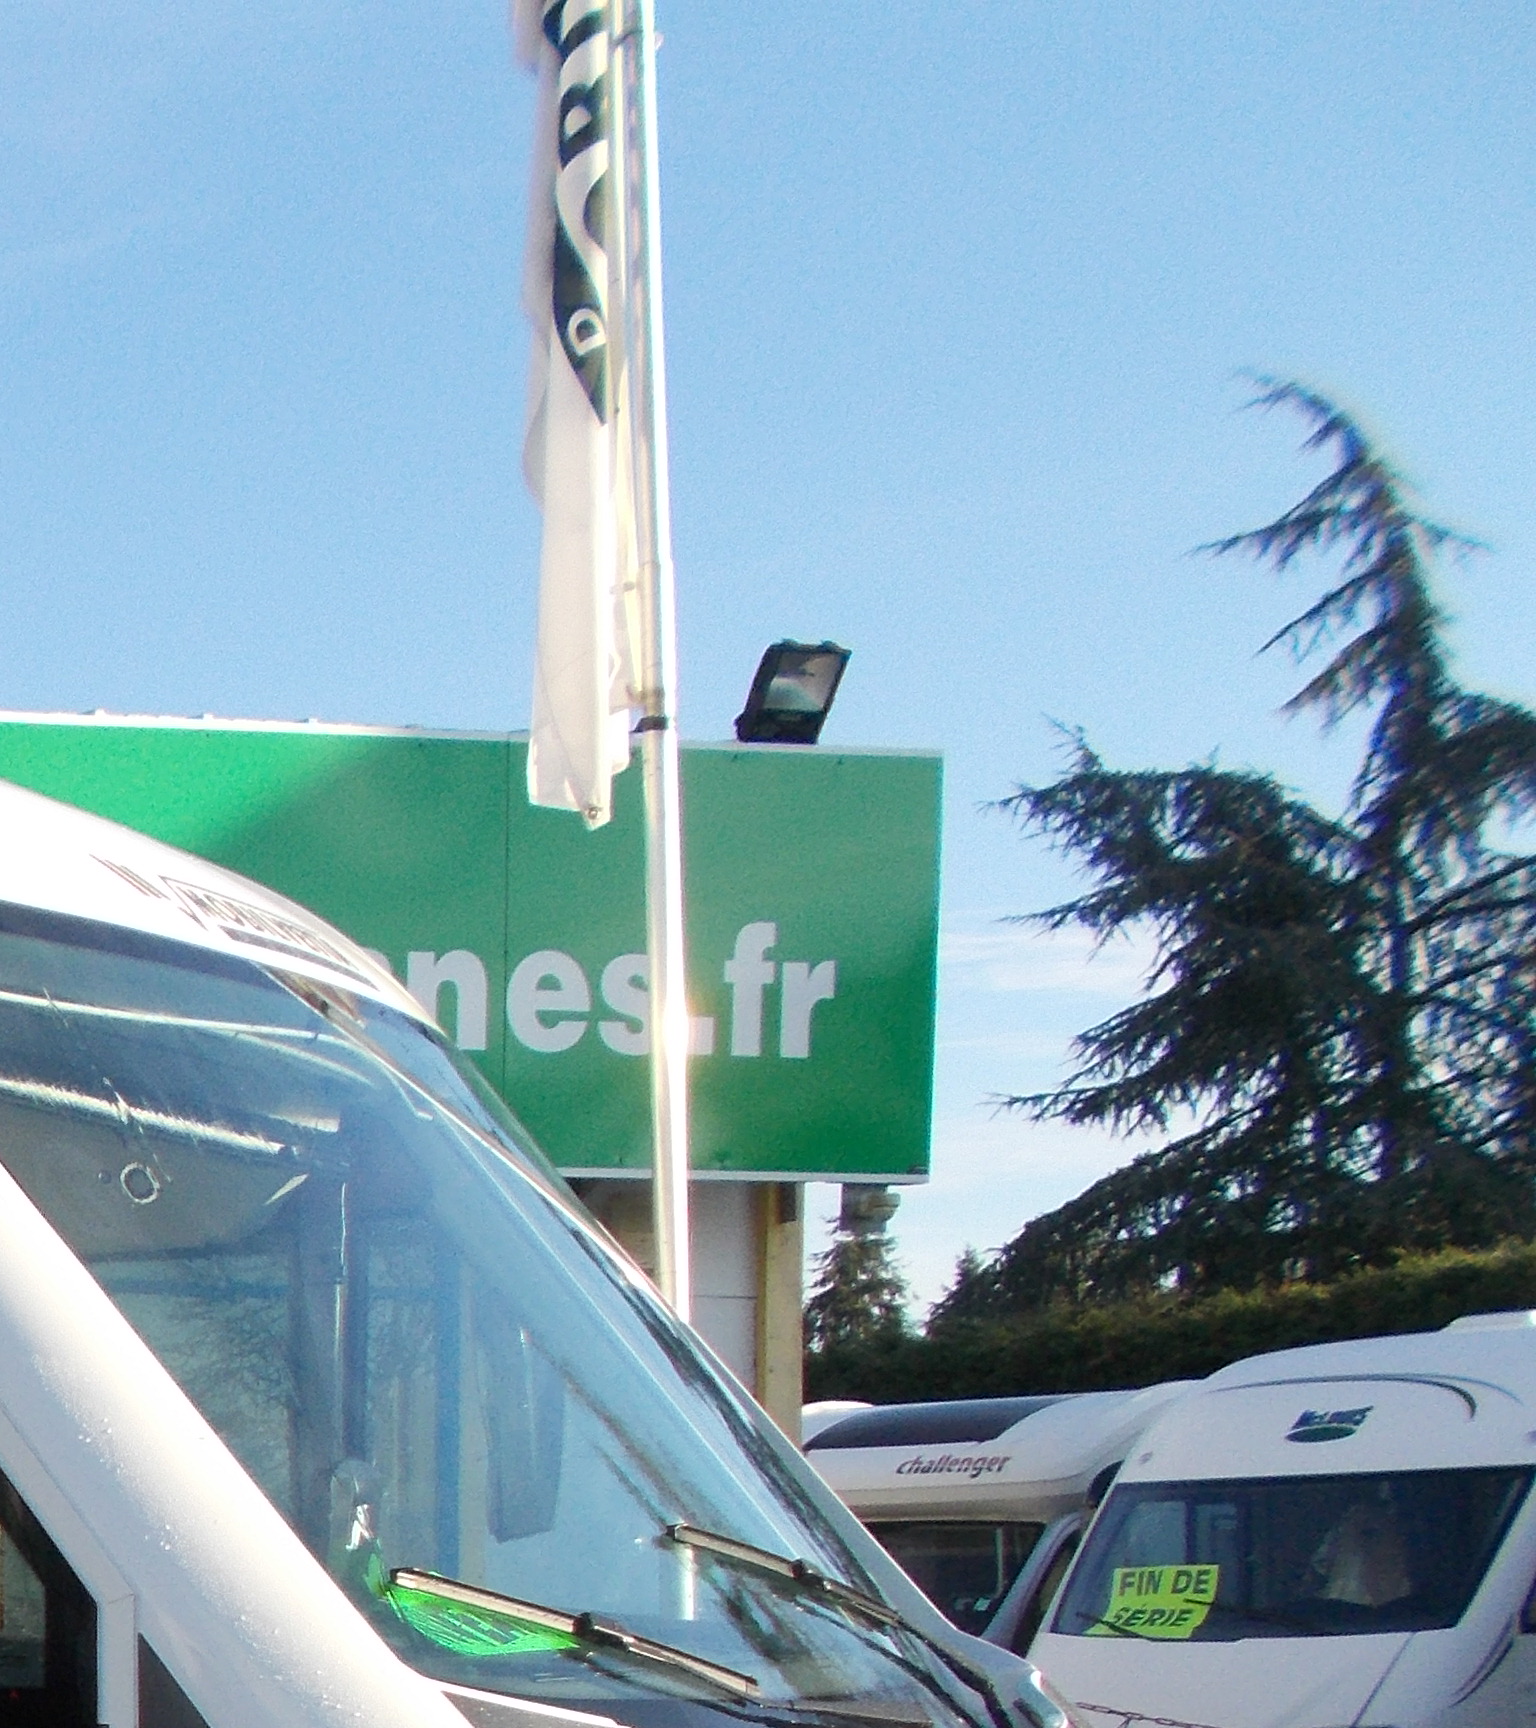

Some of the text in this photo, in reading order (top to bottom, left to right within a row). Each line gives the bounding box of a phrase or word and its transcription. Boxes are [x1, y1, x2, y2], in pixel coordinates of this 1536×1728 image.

[895, 1454, 1012, 1478] challenger
[1118, 1568, 1211, 1597] FIN DE
